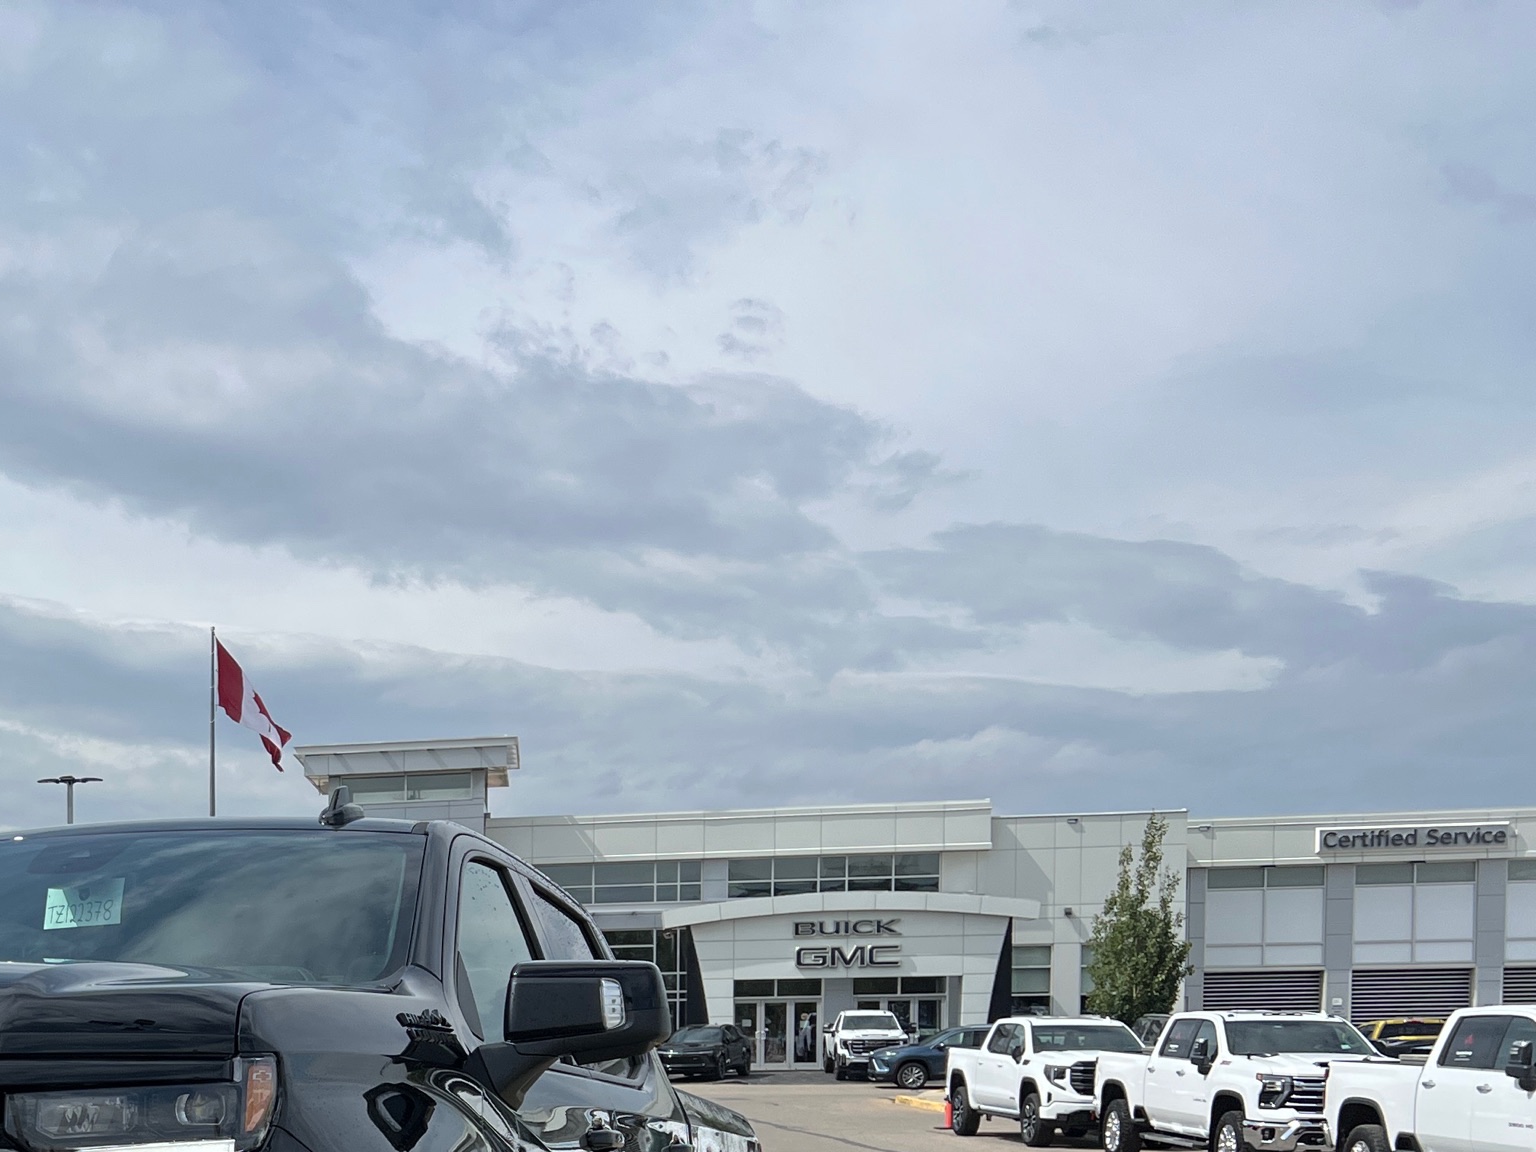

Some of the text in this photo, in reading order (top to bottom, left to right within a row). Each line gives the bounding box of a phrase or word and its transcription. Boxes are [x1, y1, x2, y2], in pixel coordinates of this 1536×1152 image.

[1322, 827, 1507, 848] Certified Service
[47, 899, 114, 924] TZ122378
[792, 918, 903, 938] BUICK
[795, 945, 902, 969] GMC
